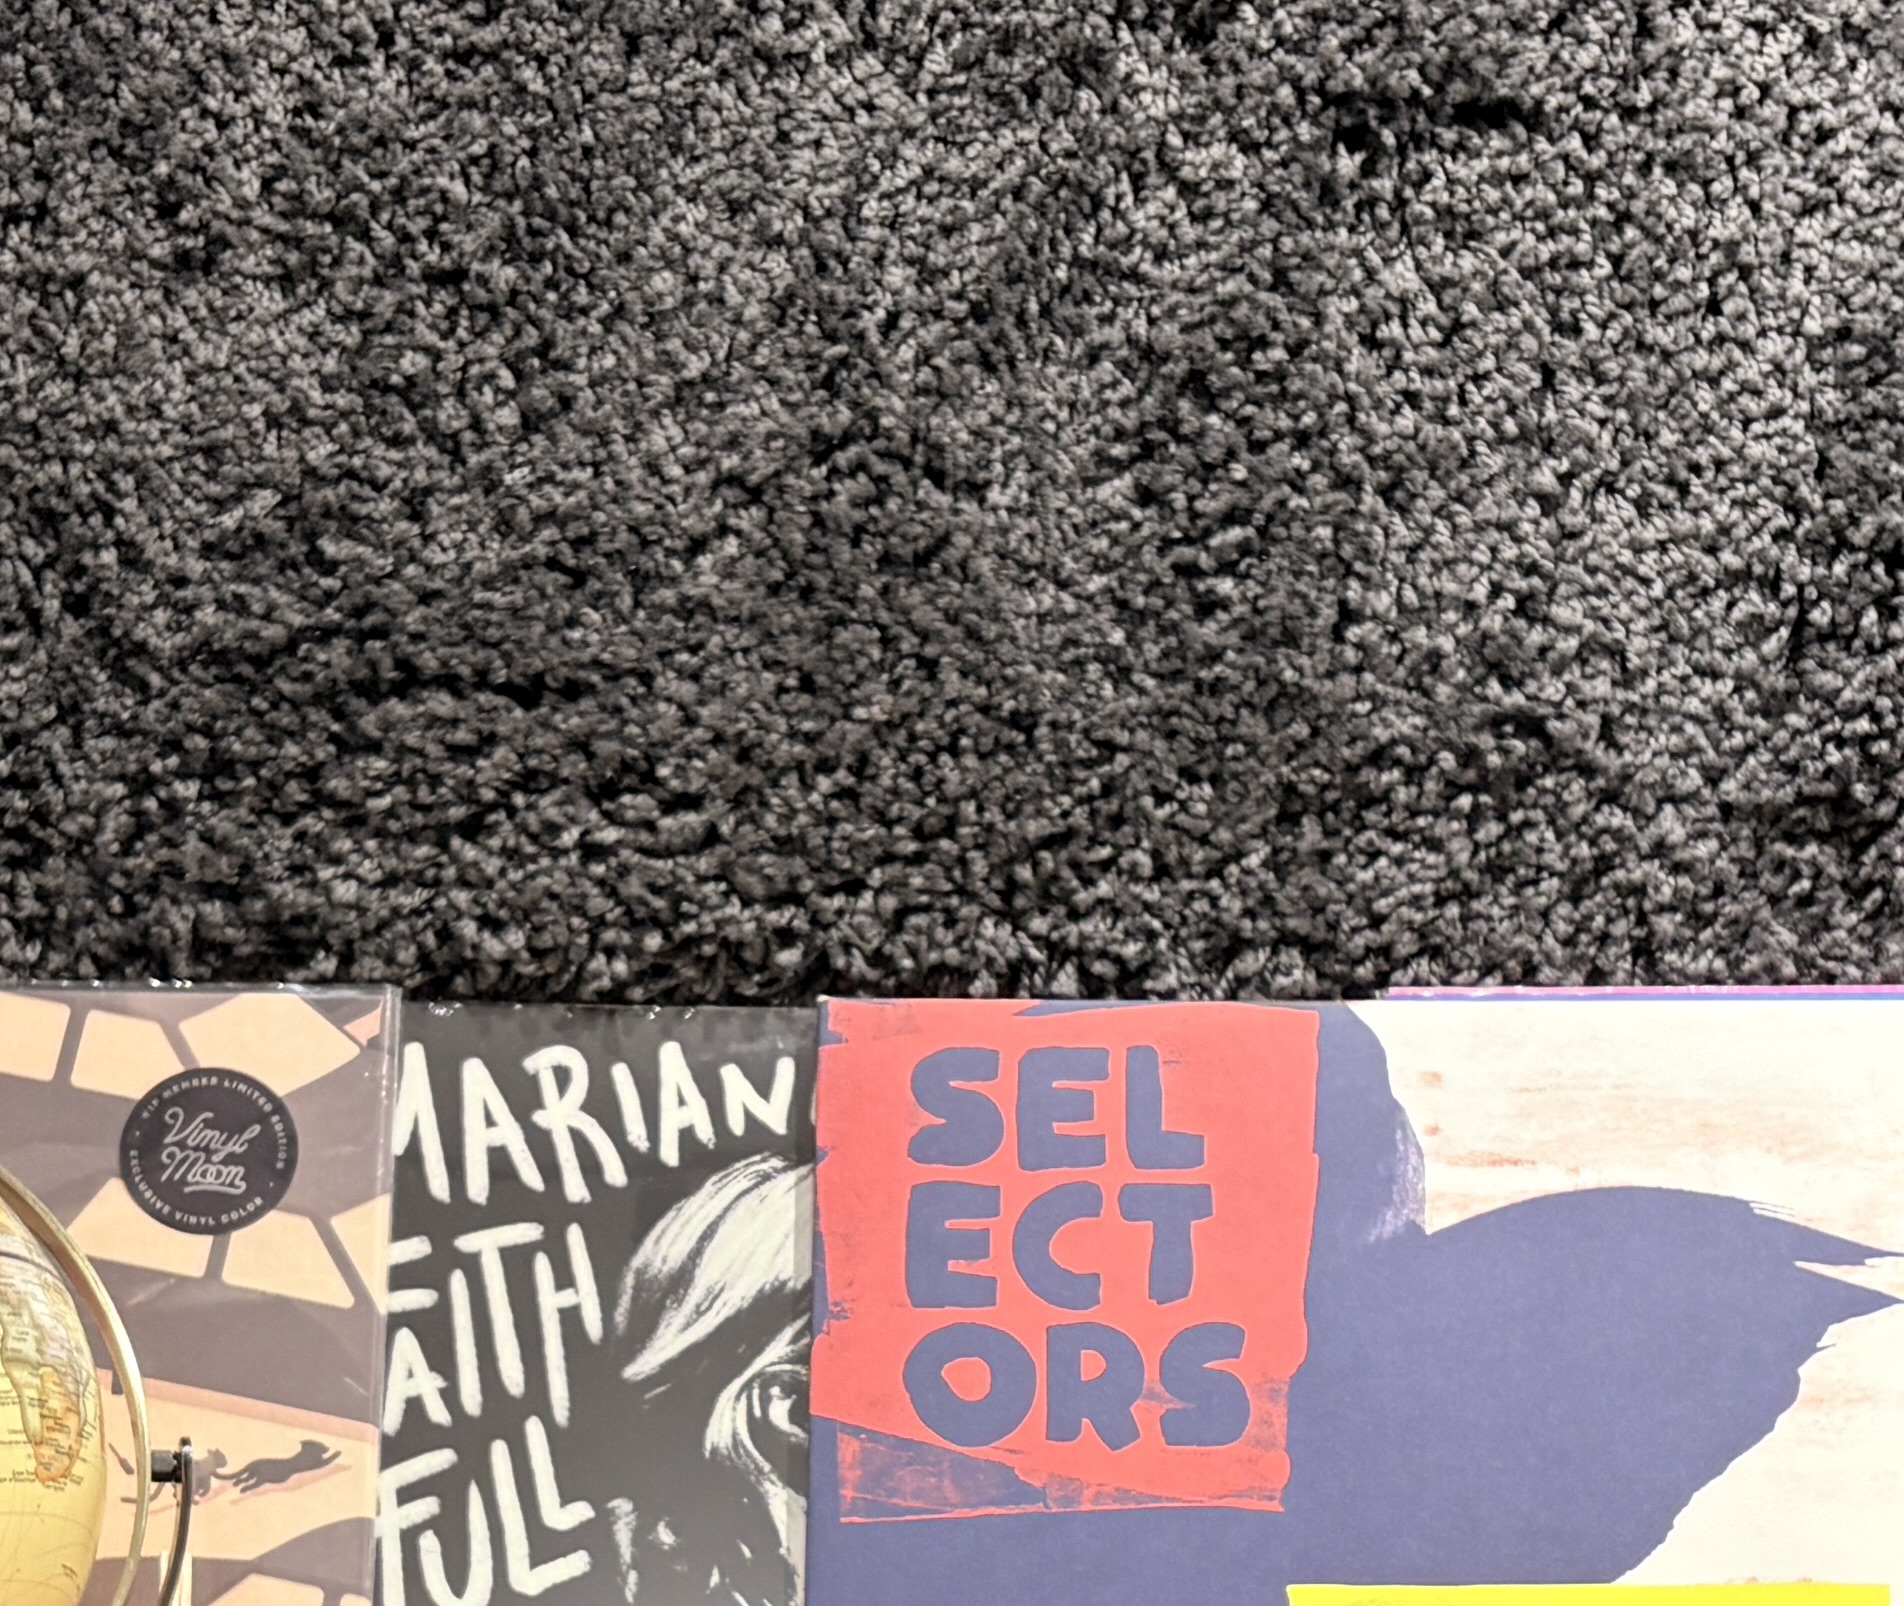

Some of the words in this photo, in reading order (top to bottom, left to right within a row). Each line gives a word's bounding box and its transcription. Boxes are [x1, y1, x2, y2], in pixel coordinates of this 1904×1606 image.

[161, 1146, 247, 1195] Moon
[163, 1106, 262, 1162] Vinyl
[906, 1045, 1206, 1173] SEL
[904, 1180, 1214, 1312] ECT
[902, 1322, 1252, 1452] ORS
